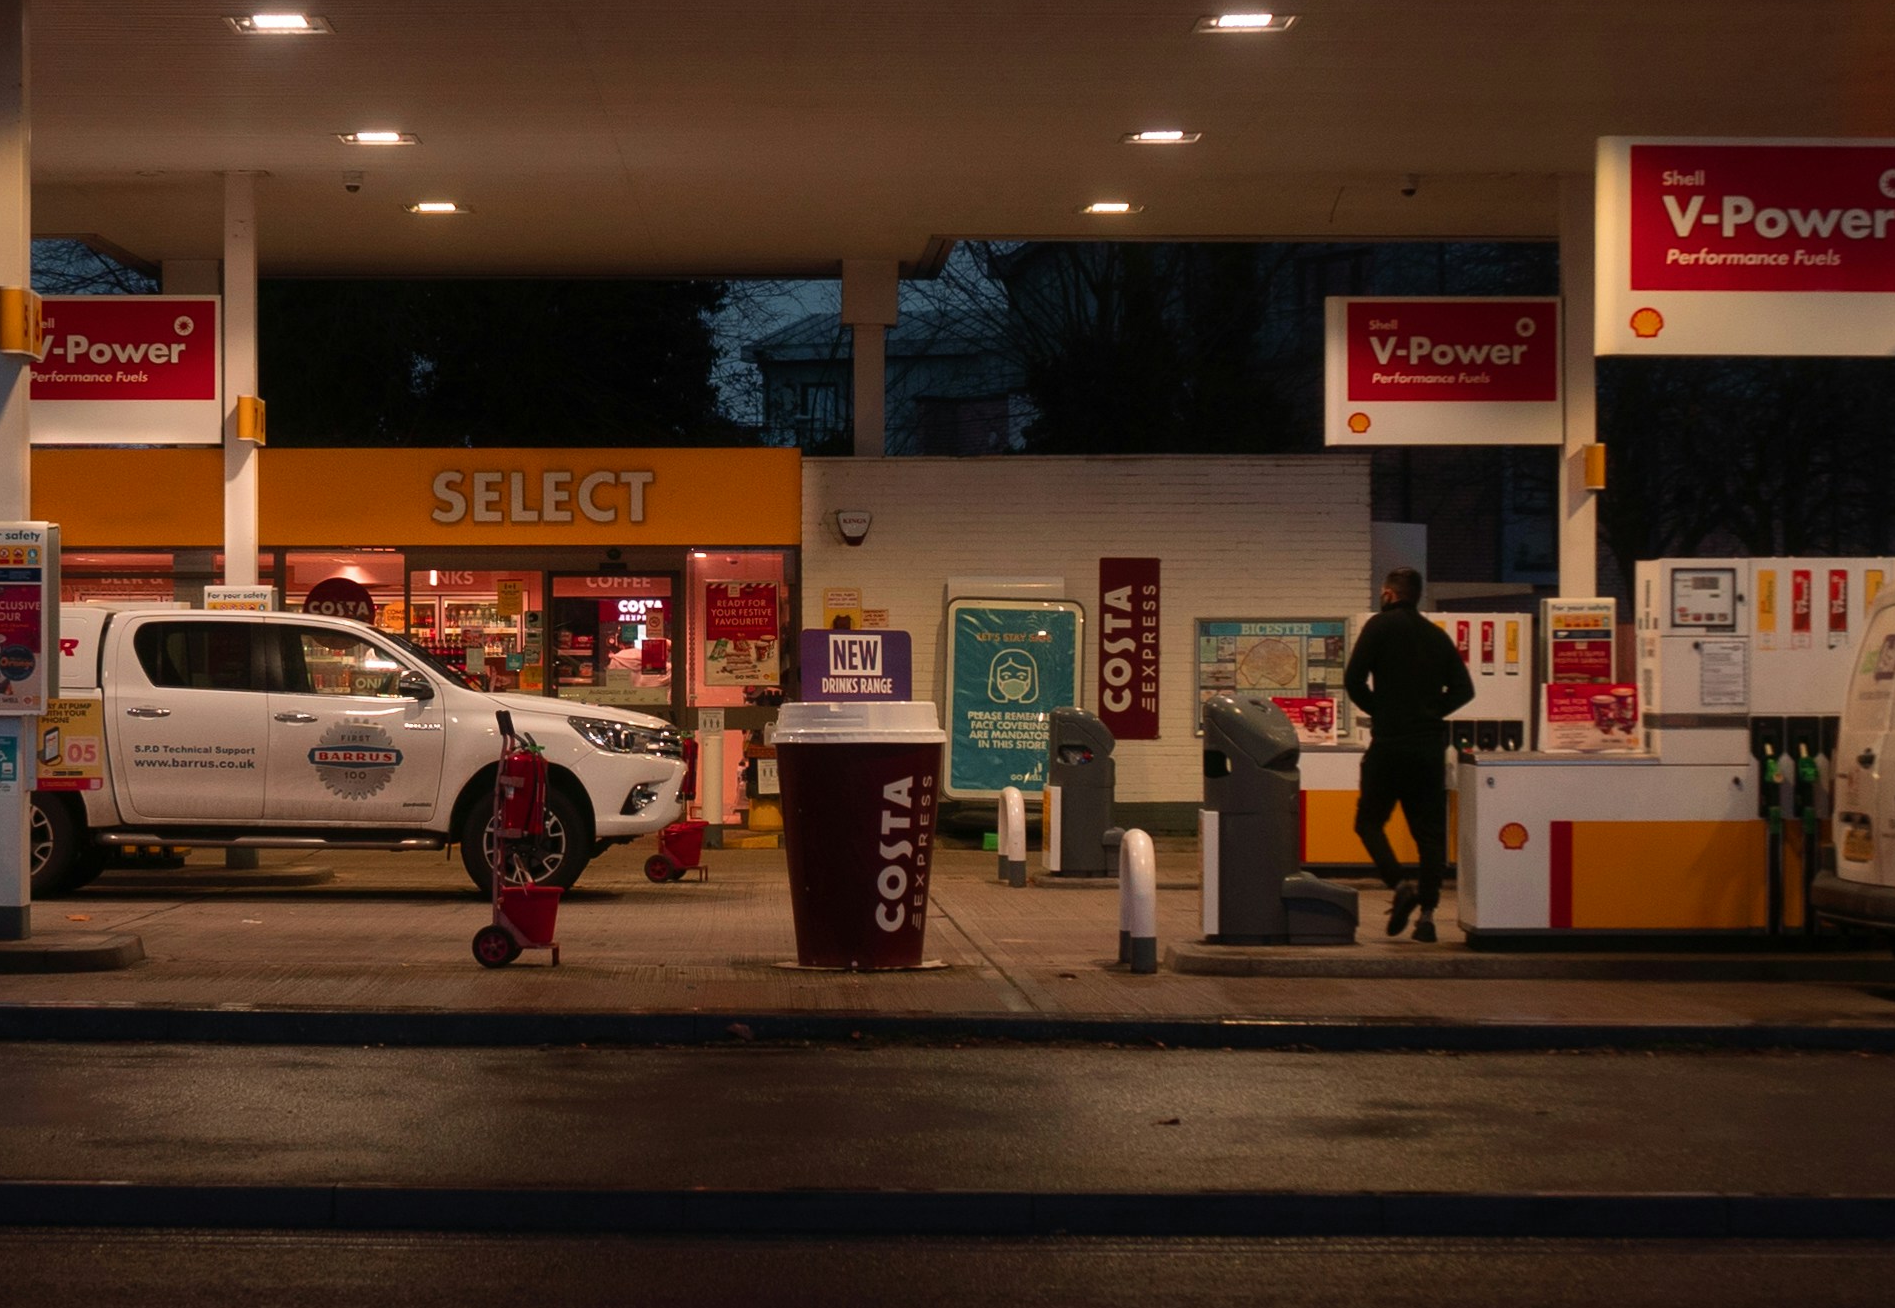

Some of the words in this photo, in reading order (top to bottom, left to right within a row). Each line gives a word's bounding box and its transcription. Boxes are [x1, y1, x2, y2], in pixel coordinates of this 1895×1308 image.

[1661, 169, 1705, 186] Shell
[1666, 247, 1789, 266] Performance
[1793, 248, 1842, 266] Fuels
[41, 317, 55, 329] ell
[1368, 319, 1398, 331] Shell
[1368, 336, 1528, 366] V-Power
[30, 370, 113, 383] Performance
[115, 370, 149, 383] Fuels
[1371, 372, 1456, 384] Performance
[1457, 372, 1491, 384] Fuels
[431, 470, 654, 523] SELECT
[5, 531, 41, 542] safety
[223, 593, 241, 601] your
[243, 592, 267, 601] safety
[308, 600, 370, 616] COSTA
[717, 599, 746, 607] READY
[748, 599, 766, 607] FOR
[711, 609, 737, 617] YOUR
[739, 608, 772, 616] FESTIVE
[715, 617, 768, 626] FAVOURITE?
[1241, 623, 1312, 635] BICESTER
[1142, 585, 1156, 693] EXPRESS
[1102, 584, 1137, 712] COSTA
[833, 640, 878, 670] NEW
[821, 677, 859, 694] DRINKS
[860, 678, 893, 694] RANGE
[967, 711, 1003, 720] PLEASE
[970, 721, 994, 729] FACE
[996, 721, 1050, 730] COVERING
[341, 734, 370, 742] FIRST
[969, 730, 988, 739] ARE
[991, 731, 1050, 740] MANDATOR
[163, 745, 212, 754] Technical
[215, 745, 255, 756] Support
[978, 740, 990, 748] IN
[992, 740, 1013, 749] THIS
[1015, 740, 1047, 750] STORE
[68, 744, 96, 762] 05
[318, 752, 392, 761] BARRUS
[134, 758, 255, 769] www.barrus.co.uk
[345, 771, 366, 780] 100
[914, 775, 933, 906] EXPRESS
[875, 775, 914, 932] COSTA
